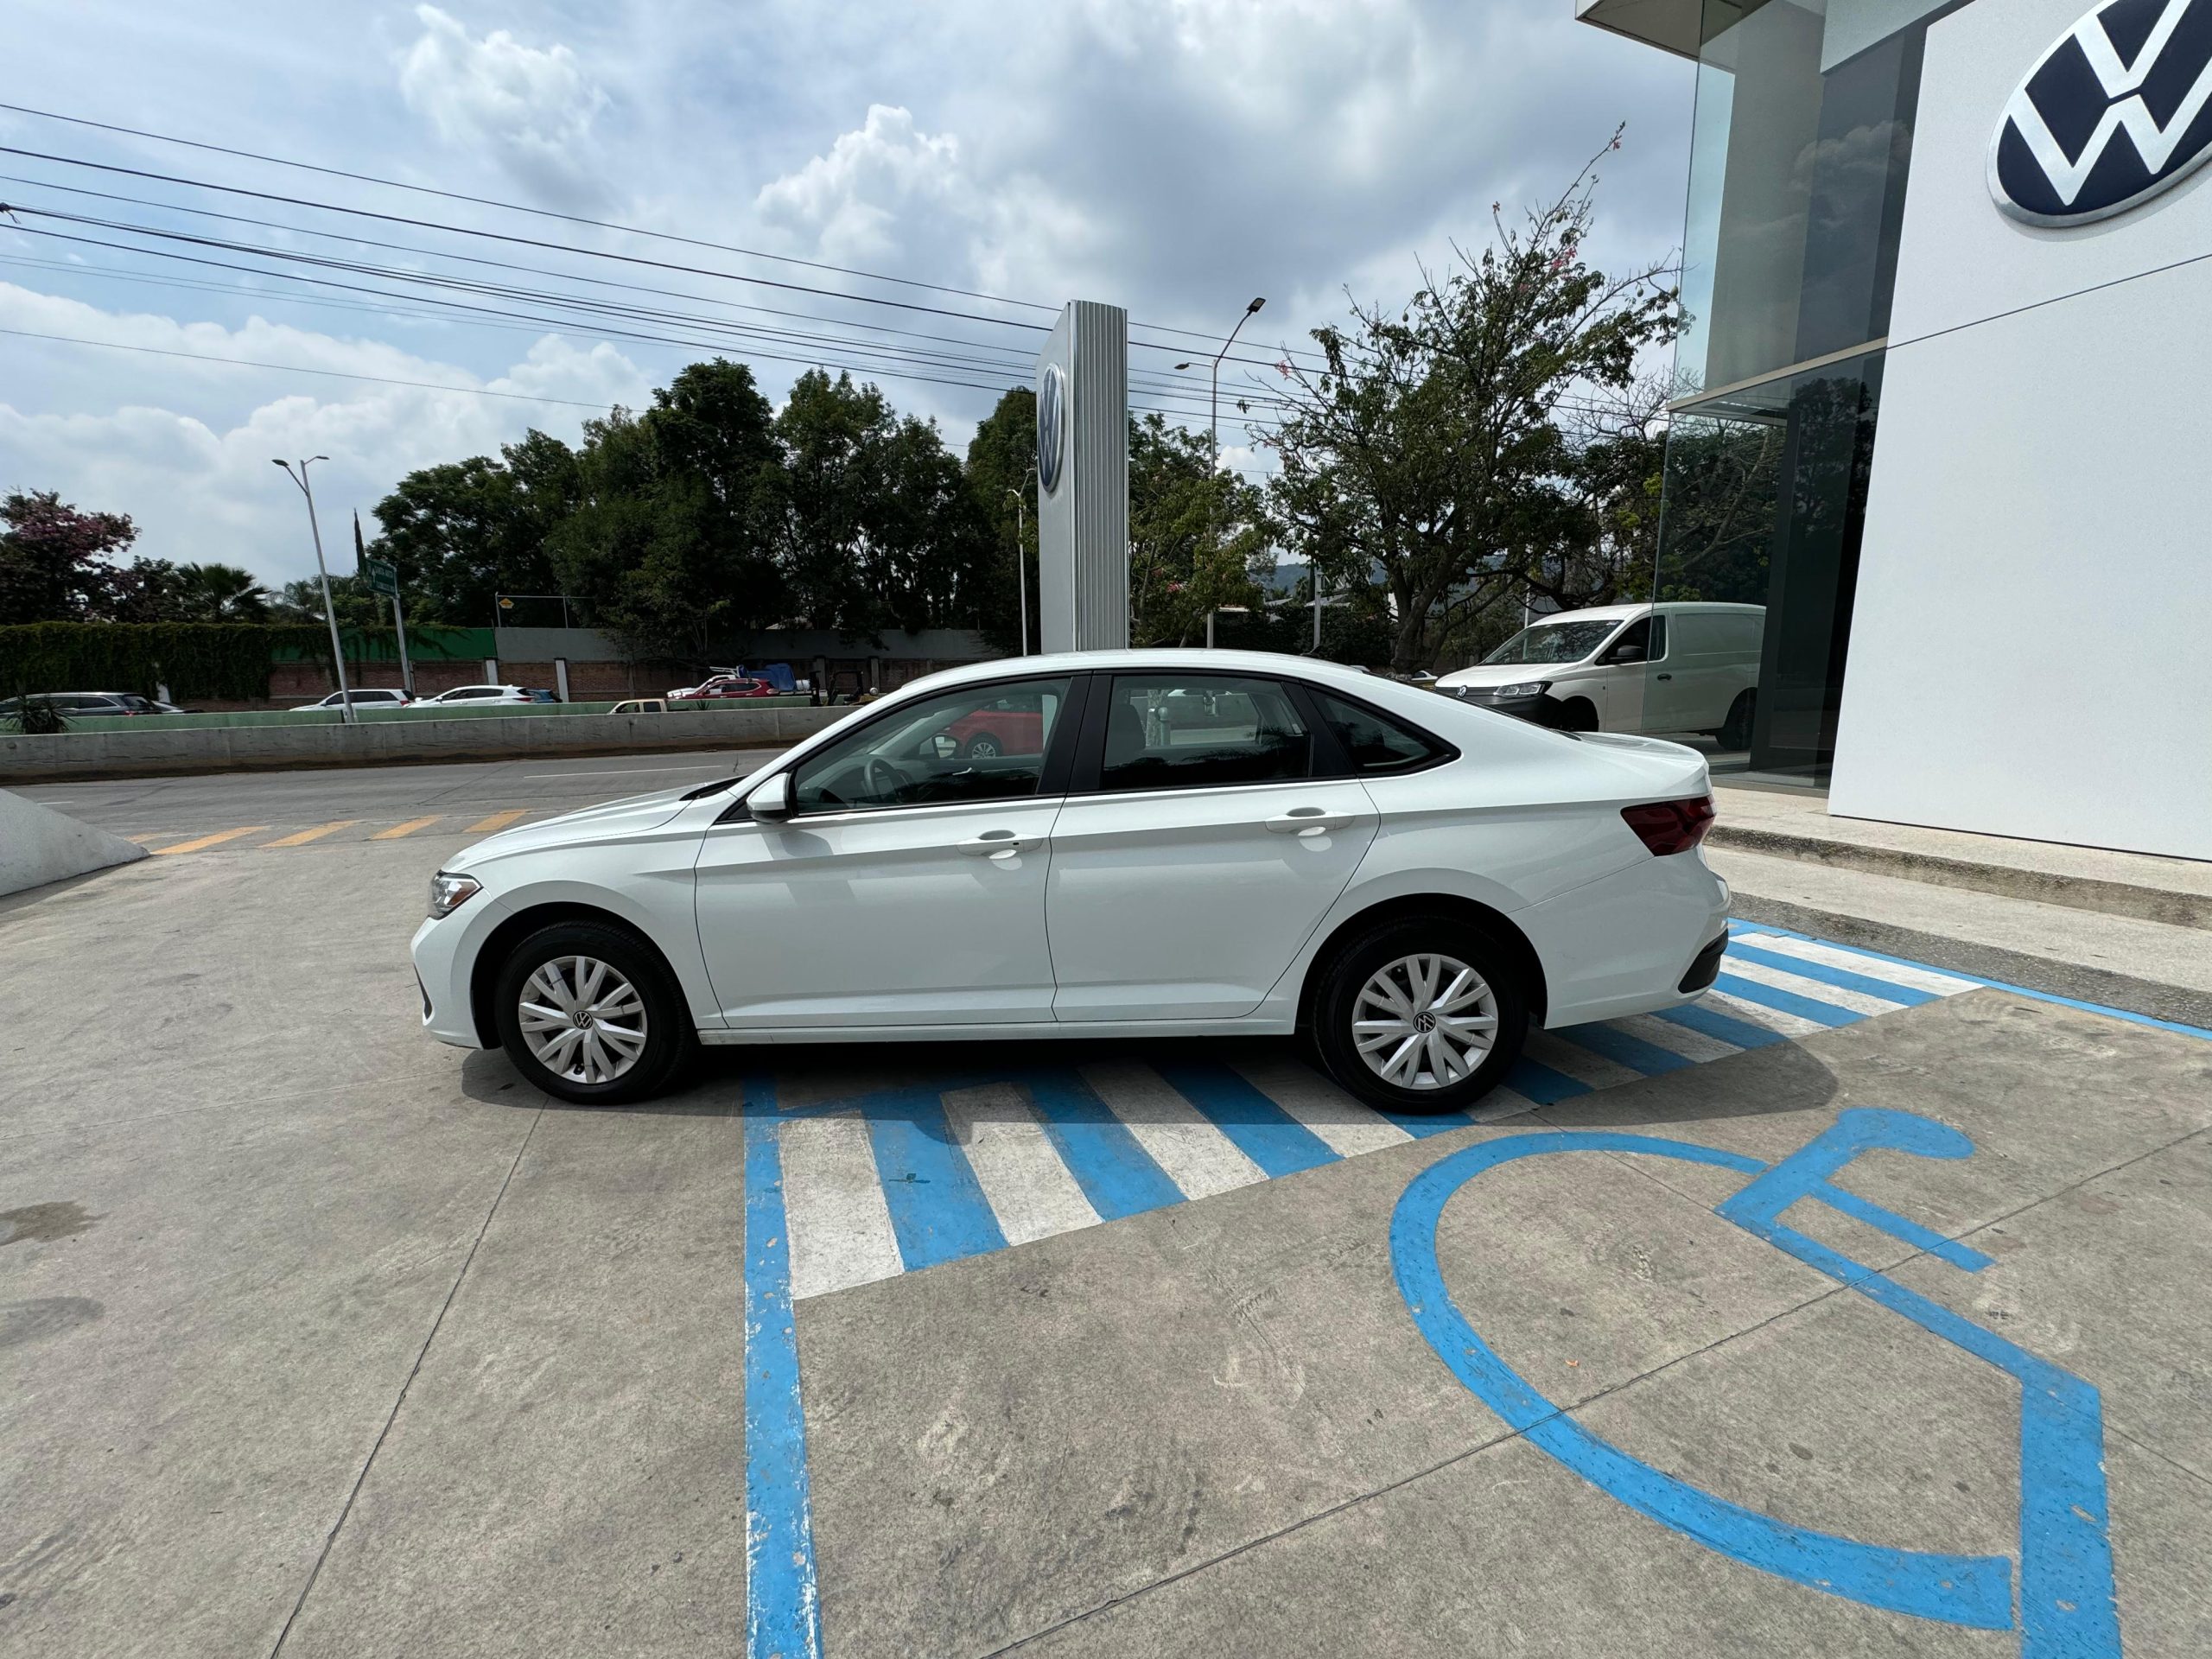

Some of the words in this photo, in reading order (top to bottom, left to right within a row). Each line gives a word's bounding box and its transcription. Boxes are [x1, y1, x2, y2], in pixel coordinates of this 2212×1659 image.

[2008, 0, 2212, 207] VW
[1039, 366, 1062, 480] VW
[574, 1011, 593, 1029] VW
